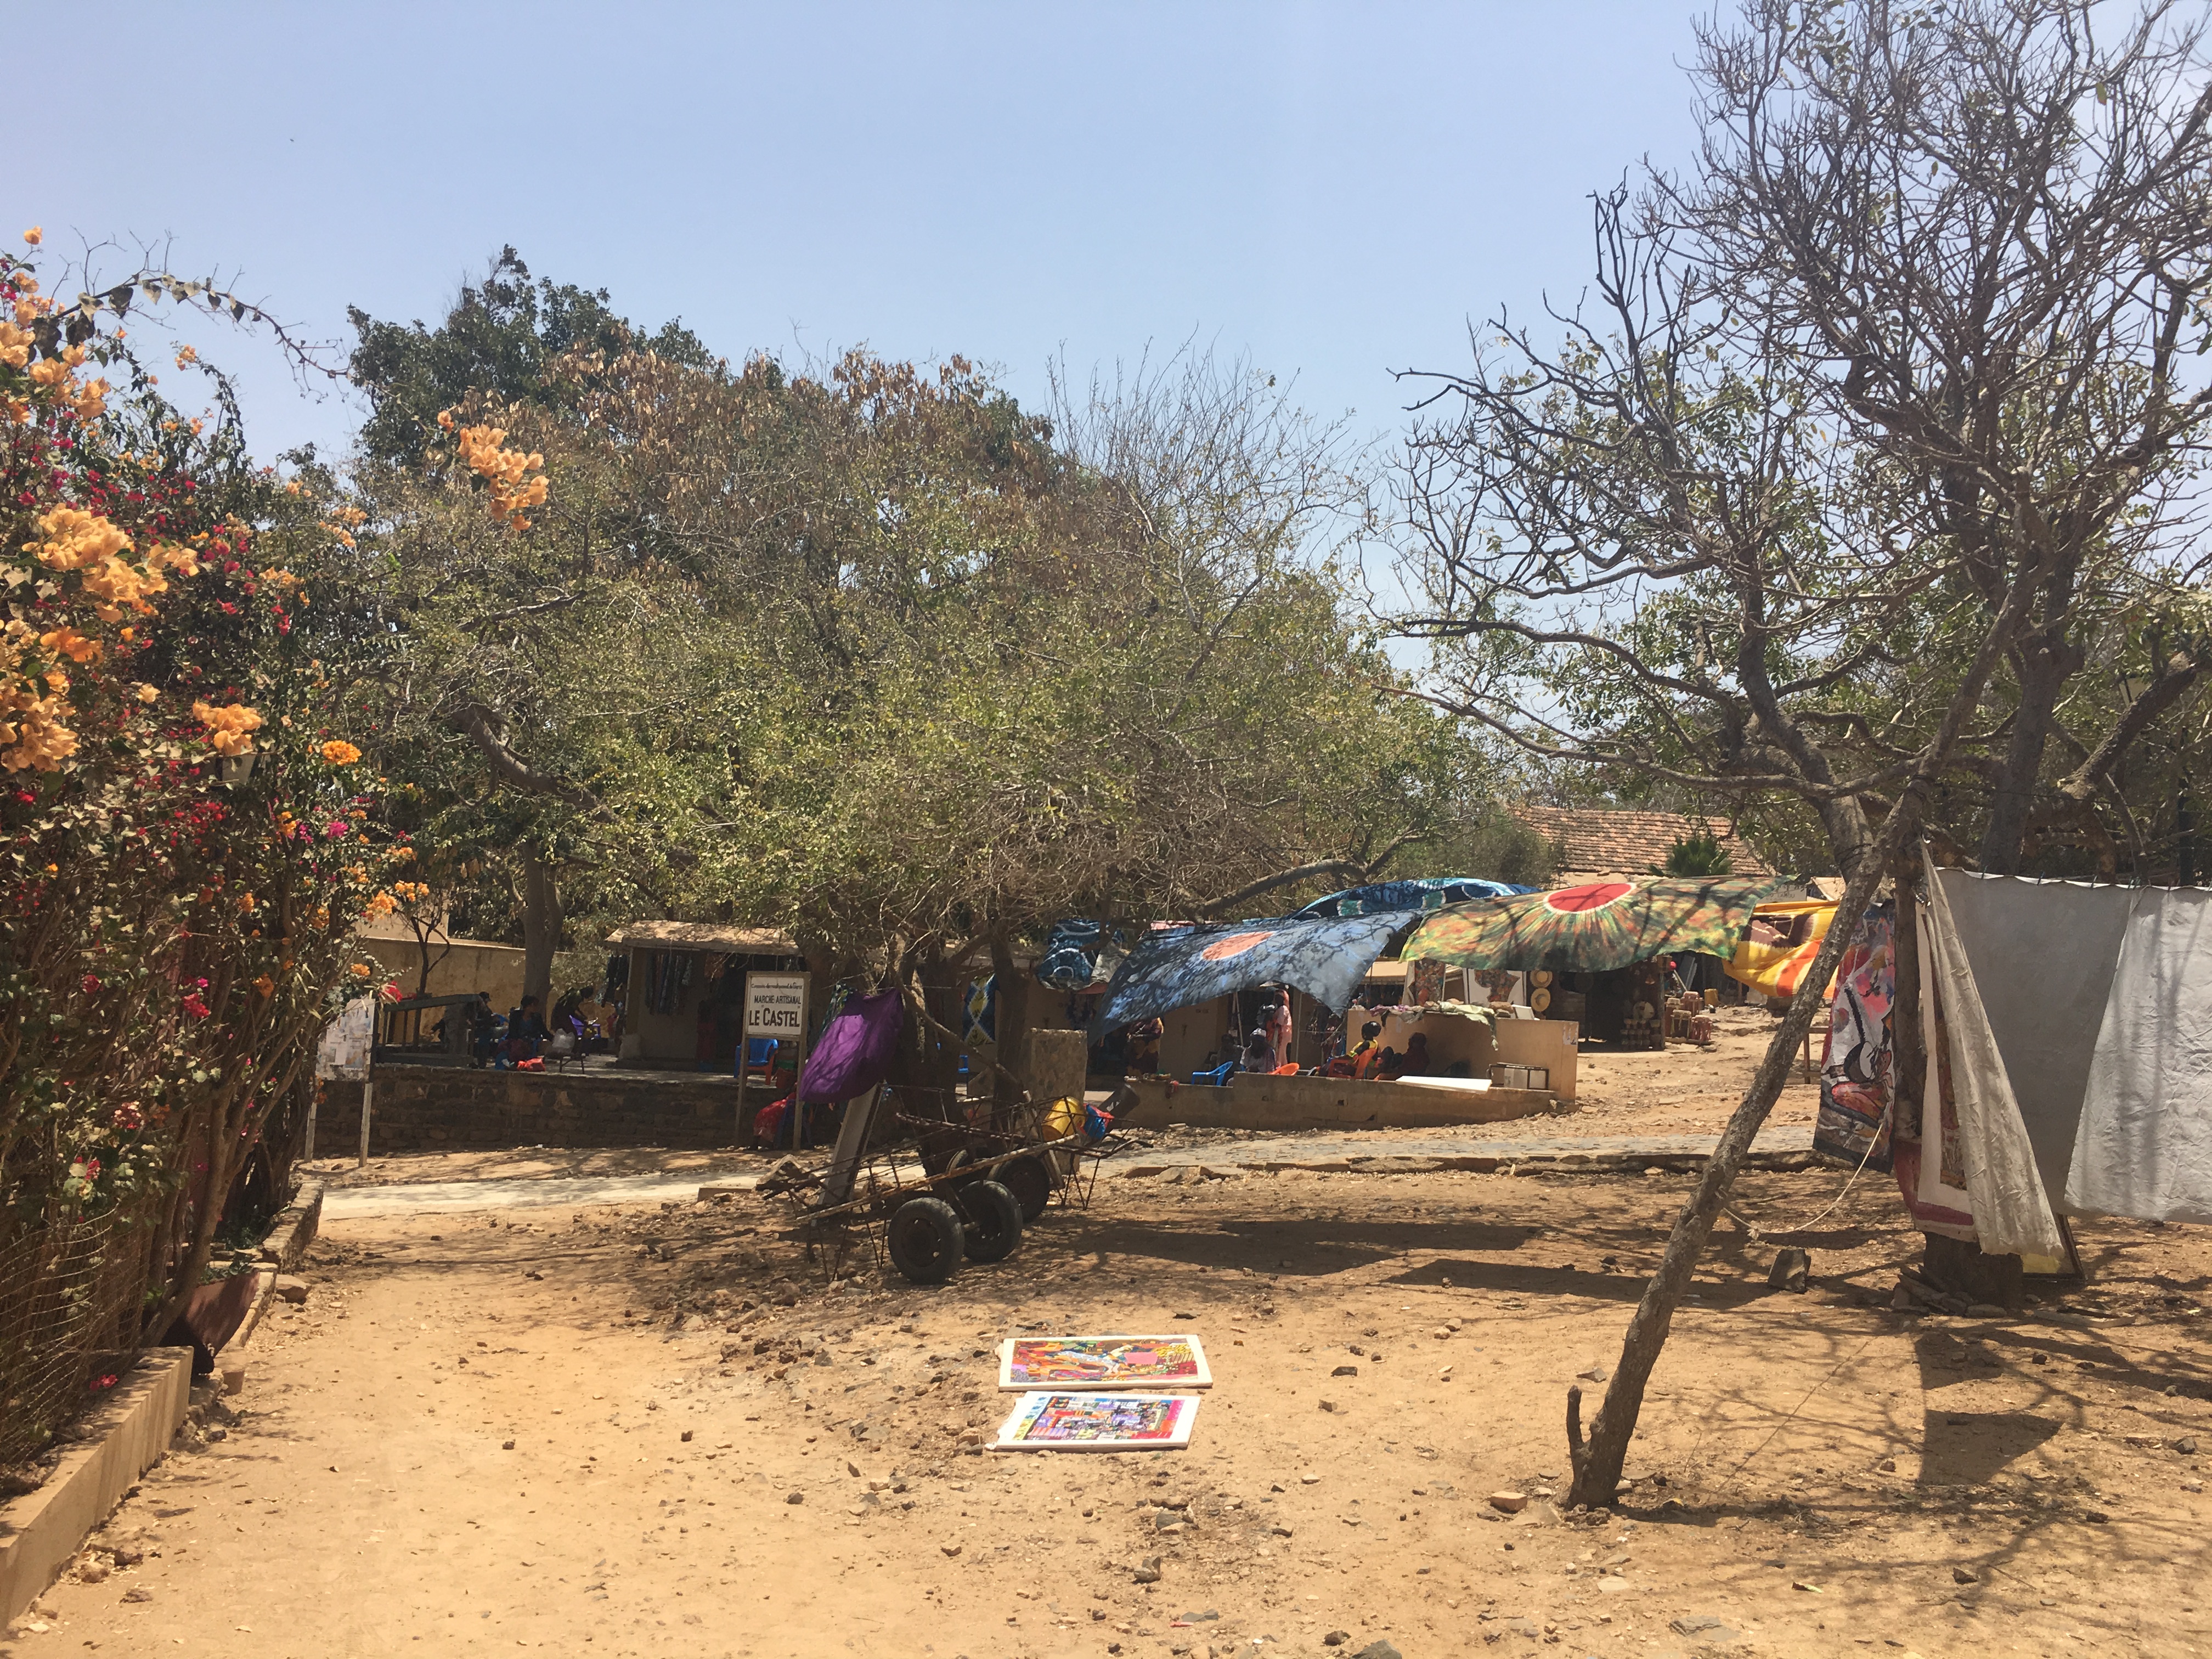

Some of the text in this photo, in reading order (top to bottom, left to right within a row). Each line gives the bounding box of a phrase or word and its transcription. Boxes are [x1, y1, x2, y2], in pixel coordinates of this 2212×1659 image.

[754, 995, 802, 1004] MARCHE ARTISANAL
[749, 1010, 760, 1026] LE
